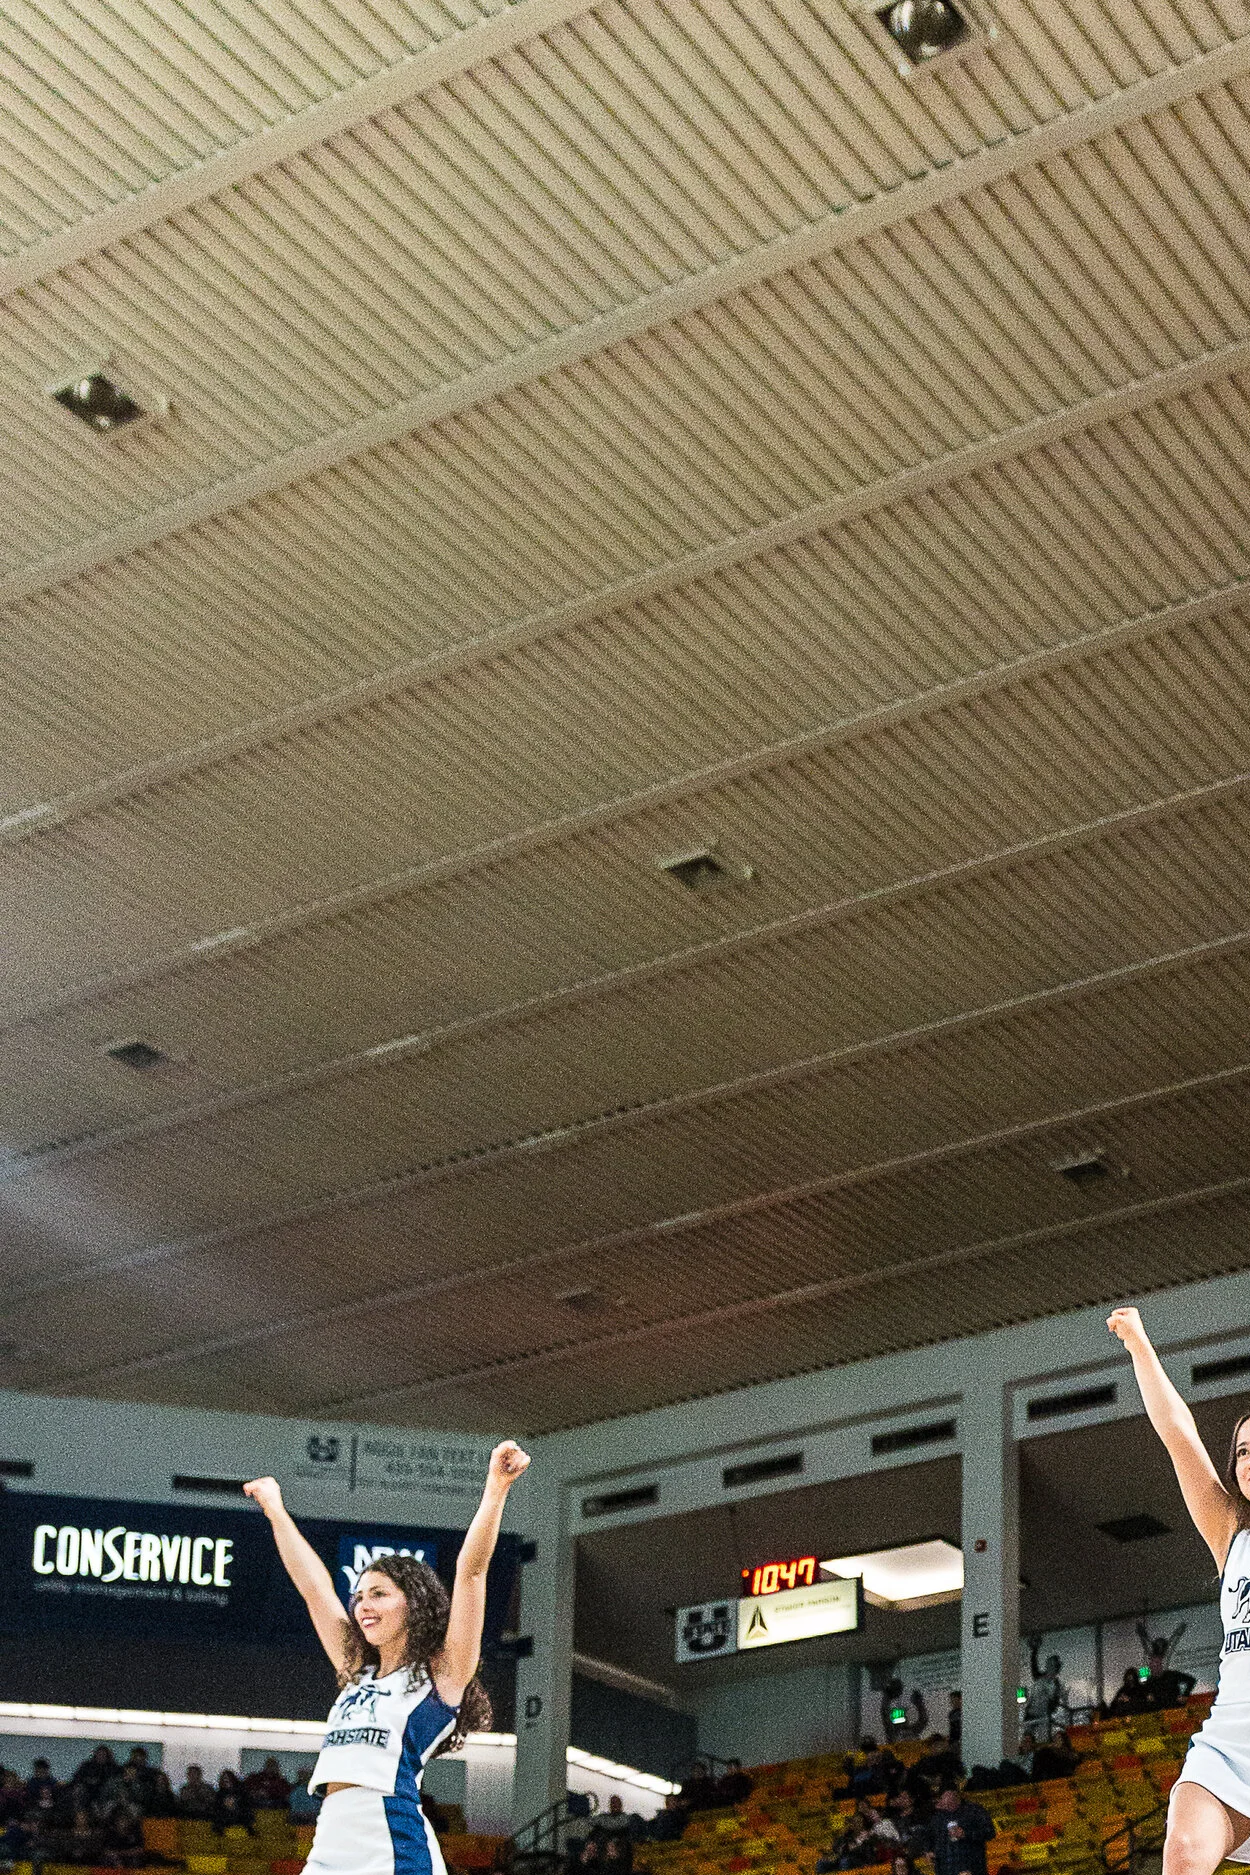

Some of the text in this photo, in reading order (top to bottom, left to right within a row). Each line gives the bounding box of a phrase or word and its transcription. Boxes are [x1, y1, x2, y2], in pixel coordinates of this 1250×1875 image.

[32, 1524, 234, 1587] CONSERVICE
[972, 1611, 989, 1638] E
[525, 1695, 543, 1719] D
